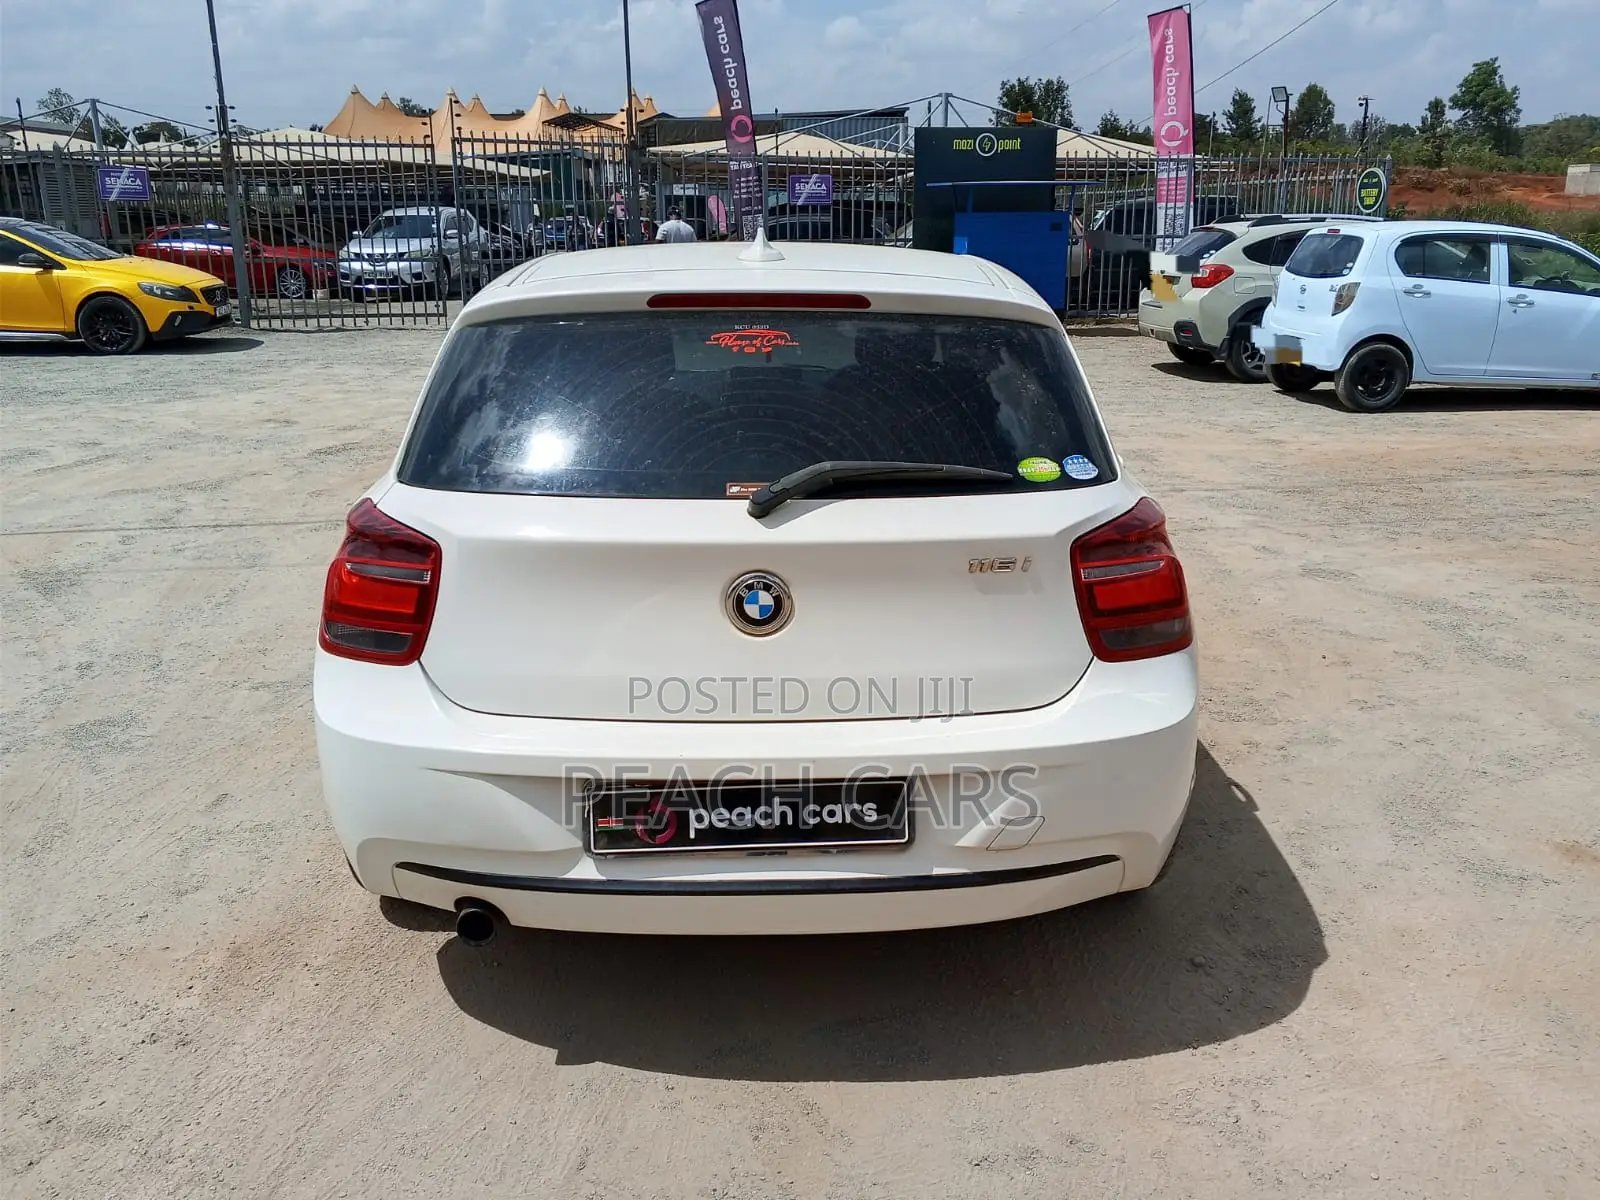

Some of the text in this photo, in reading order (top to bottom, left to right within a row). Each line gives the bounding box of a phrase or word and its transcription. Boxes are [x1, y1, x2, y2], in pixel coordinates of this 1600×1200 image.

[998, 137, 1021, 153] point
[739, 581, 780, 597] BMW
[688, 796, 878, 839] peach cars
